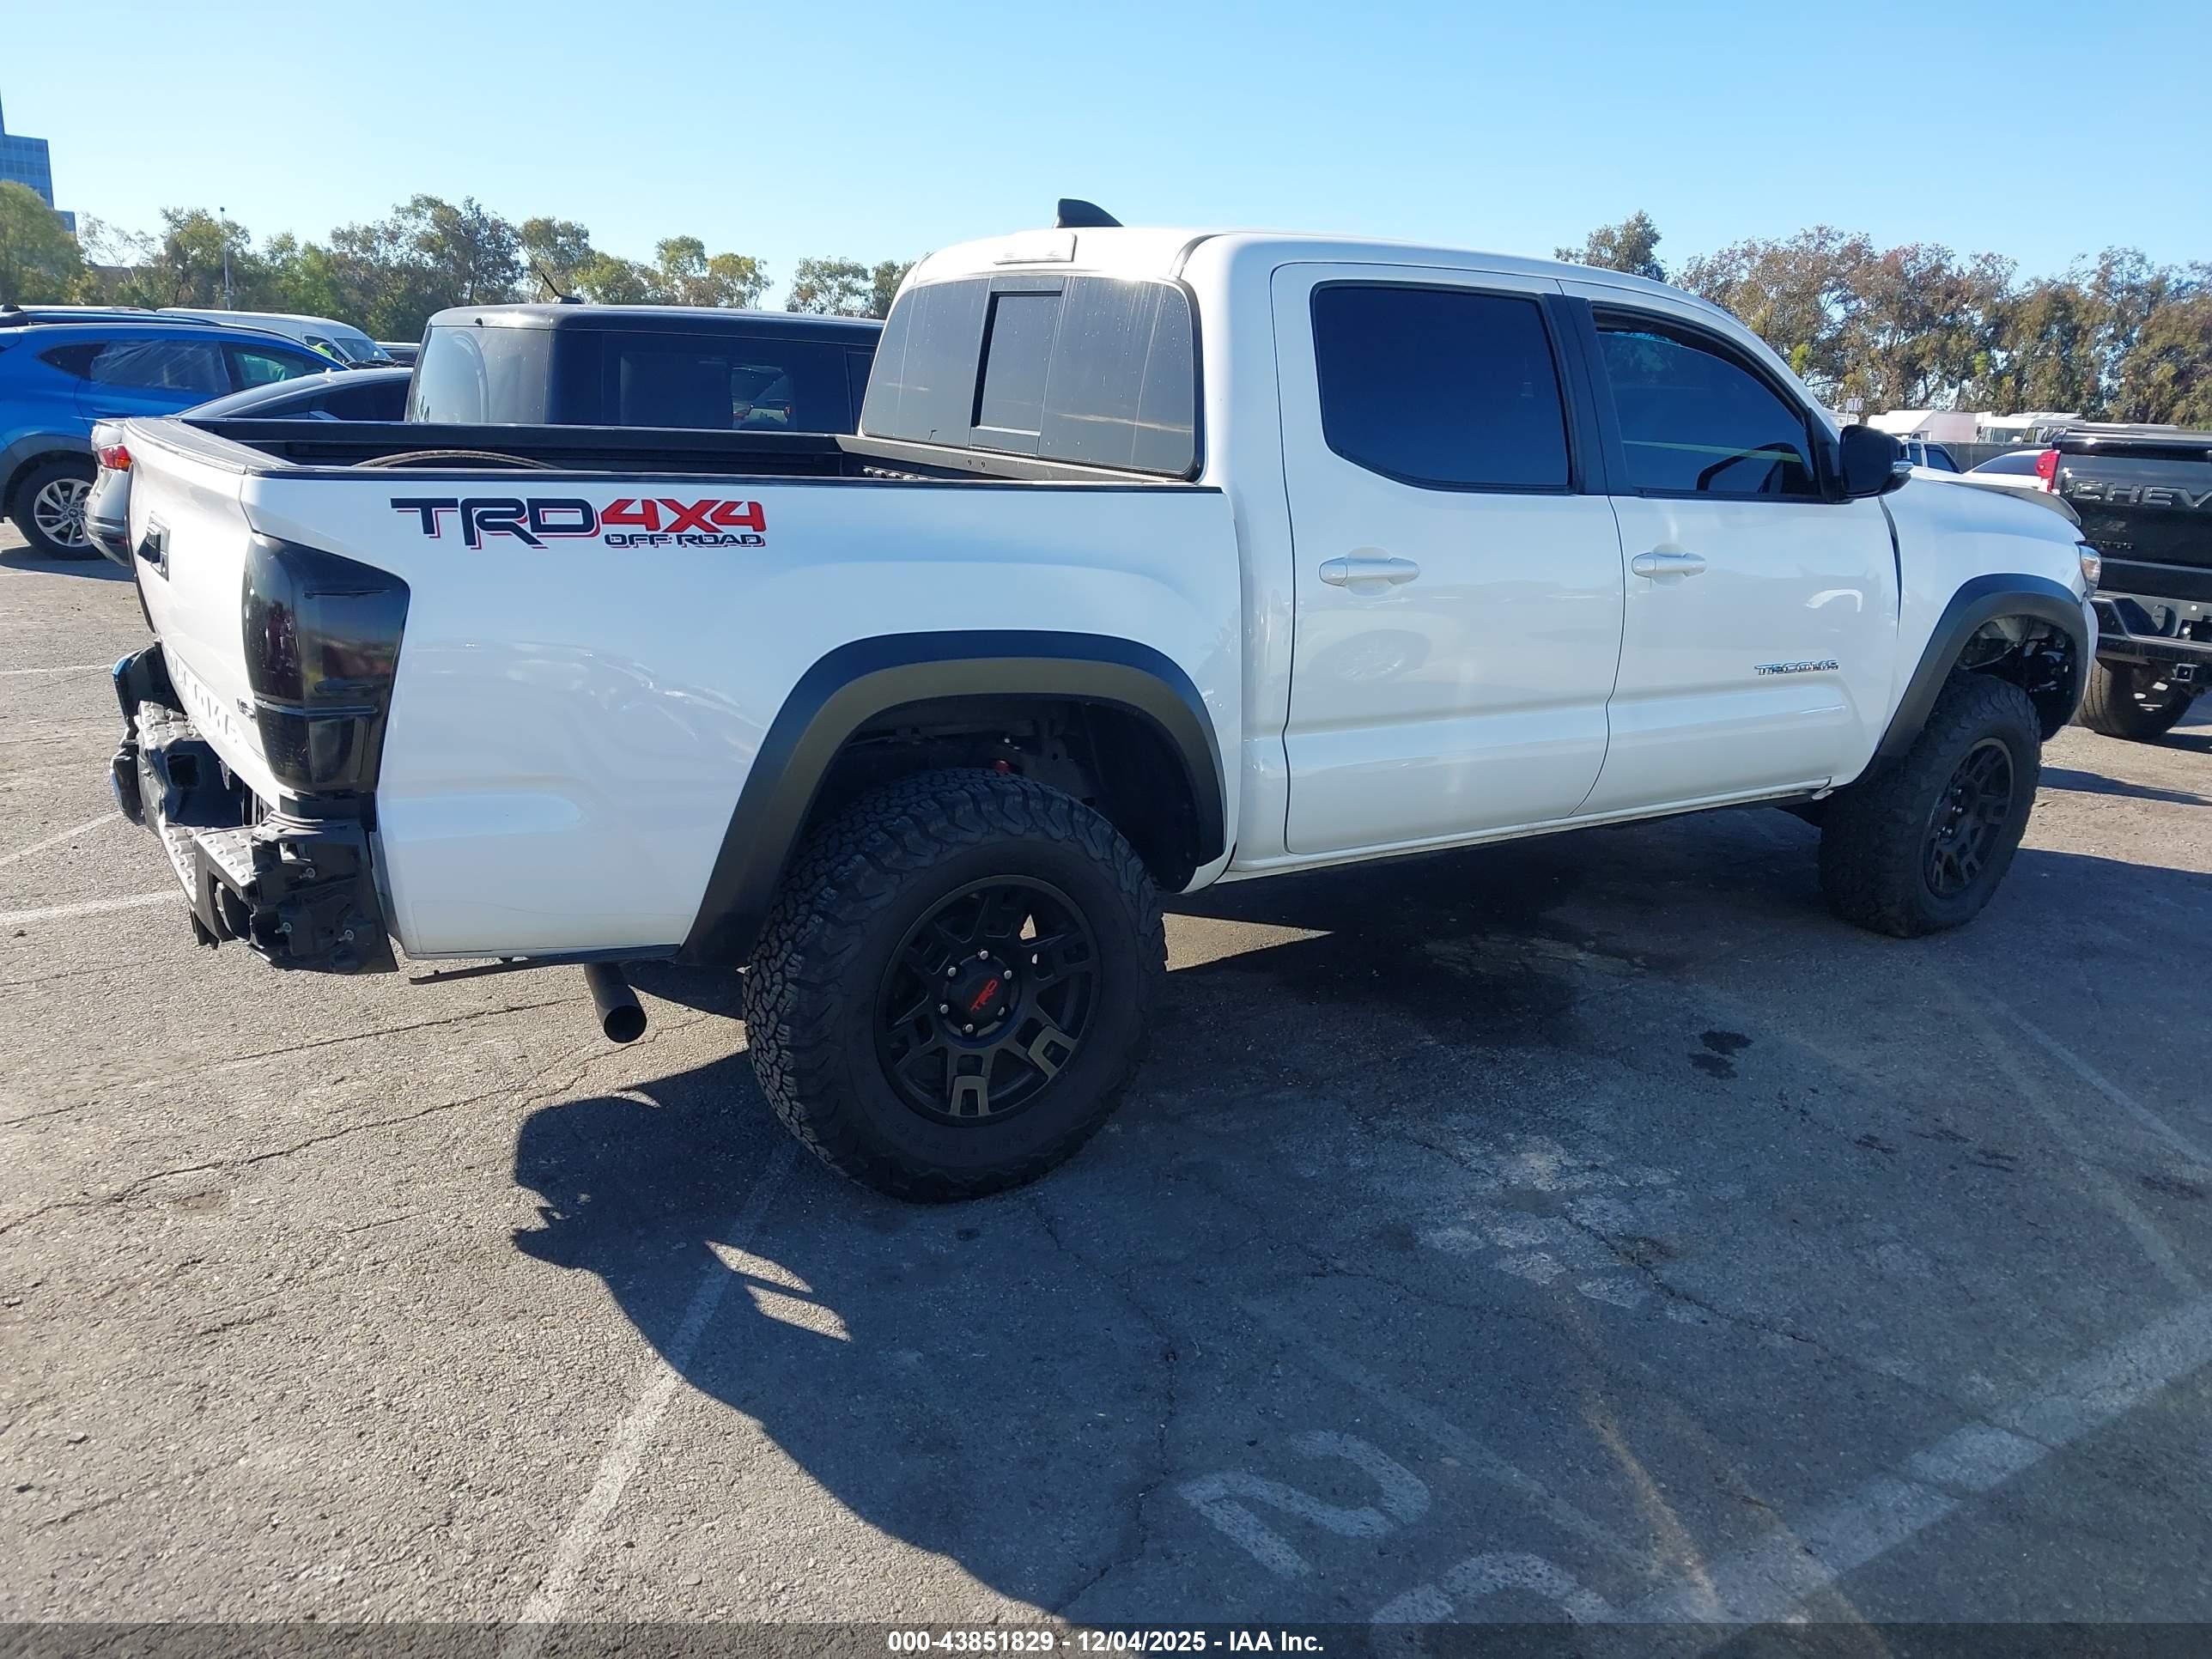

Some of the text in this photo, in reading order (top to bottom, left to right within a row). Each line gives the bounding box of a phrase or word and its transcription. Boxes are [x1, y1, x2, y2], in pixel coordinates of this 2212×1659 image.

[1850, 398, 1863, 410] 10
[390, 497, 599, 550] TRD
[605, 533, 767, 549] OFF ROAD
